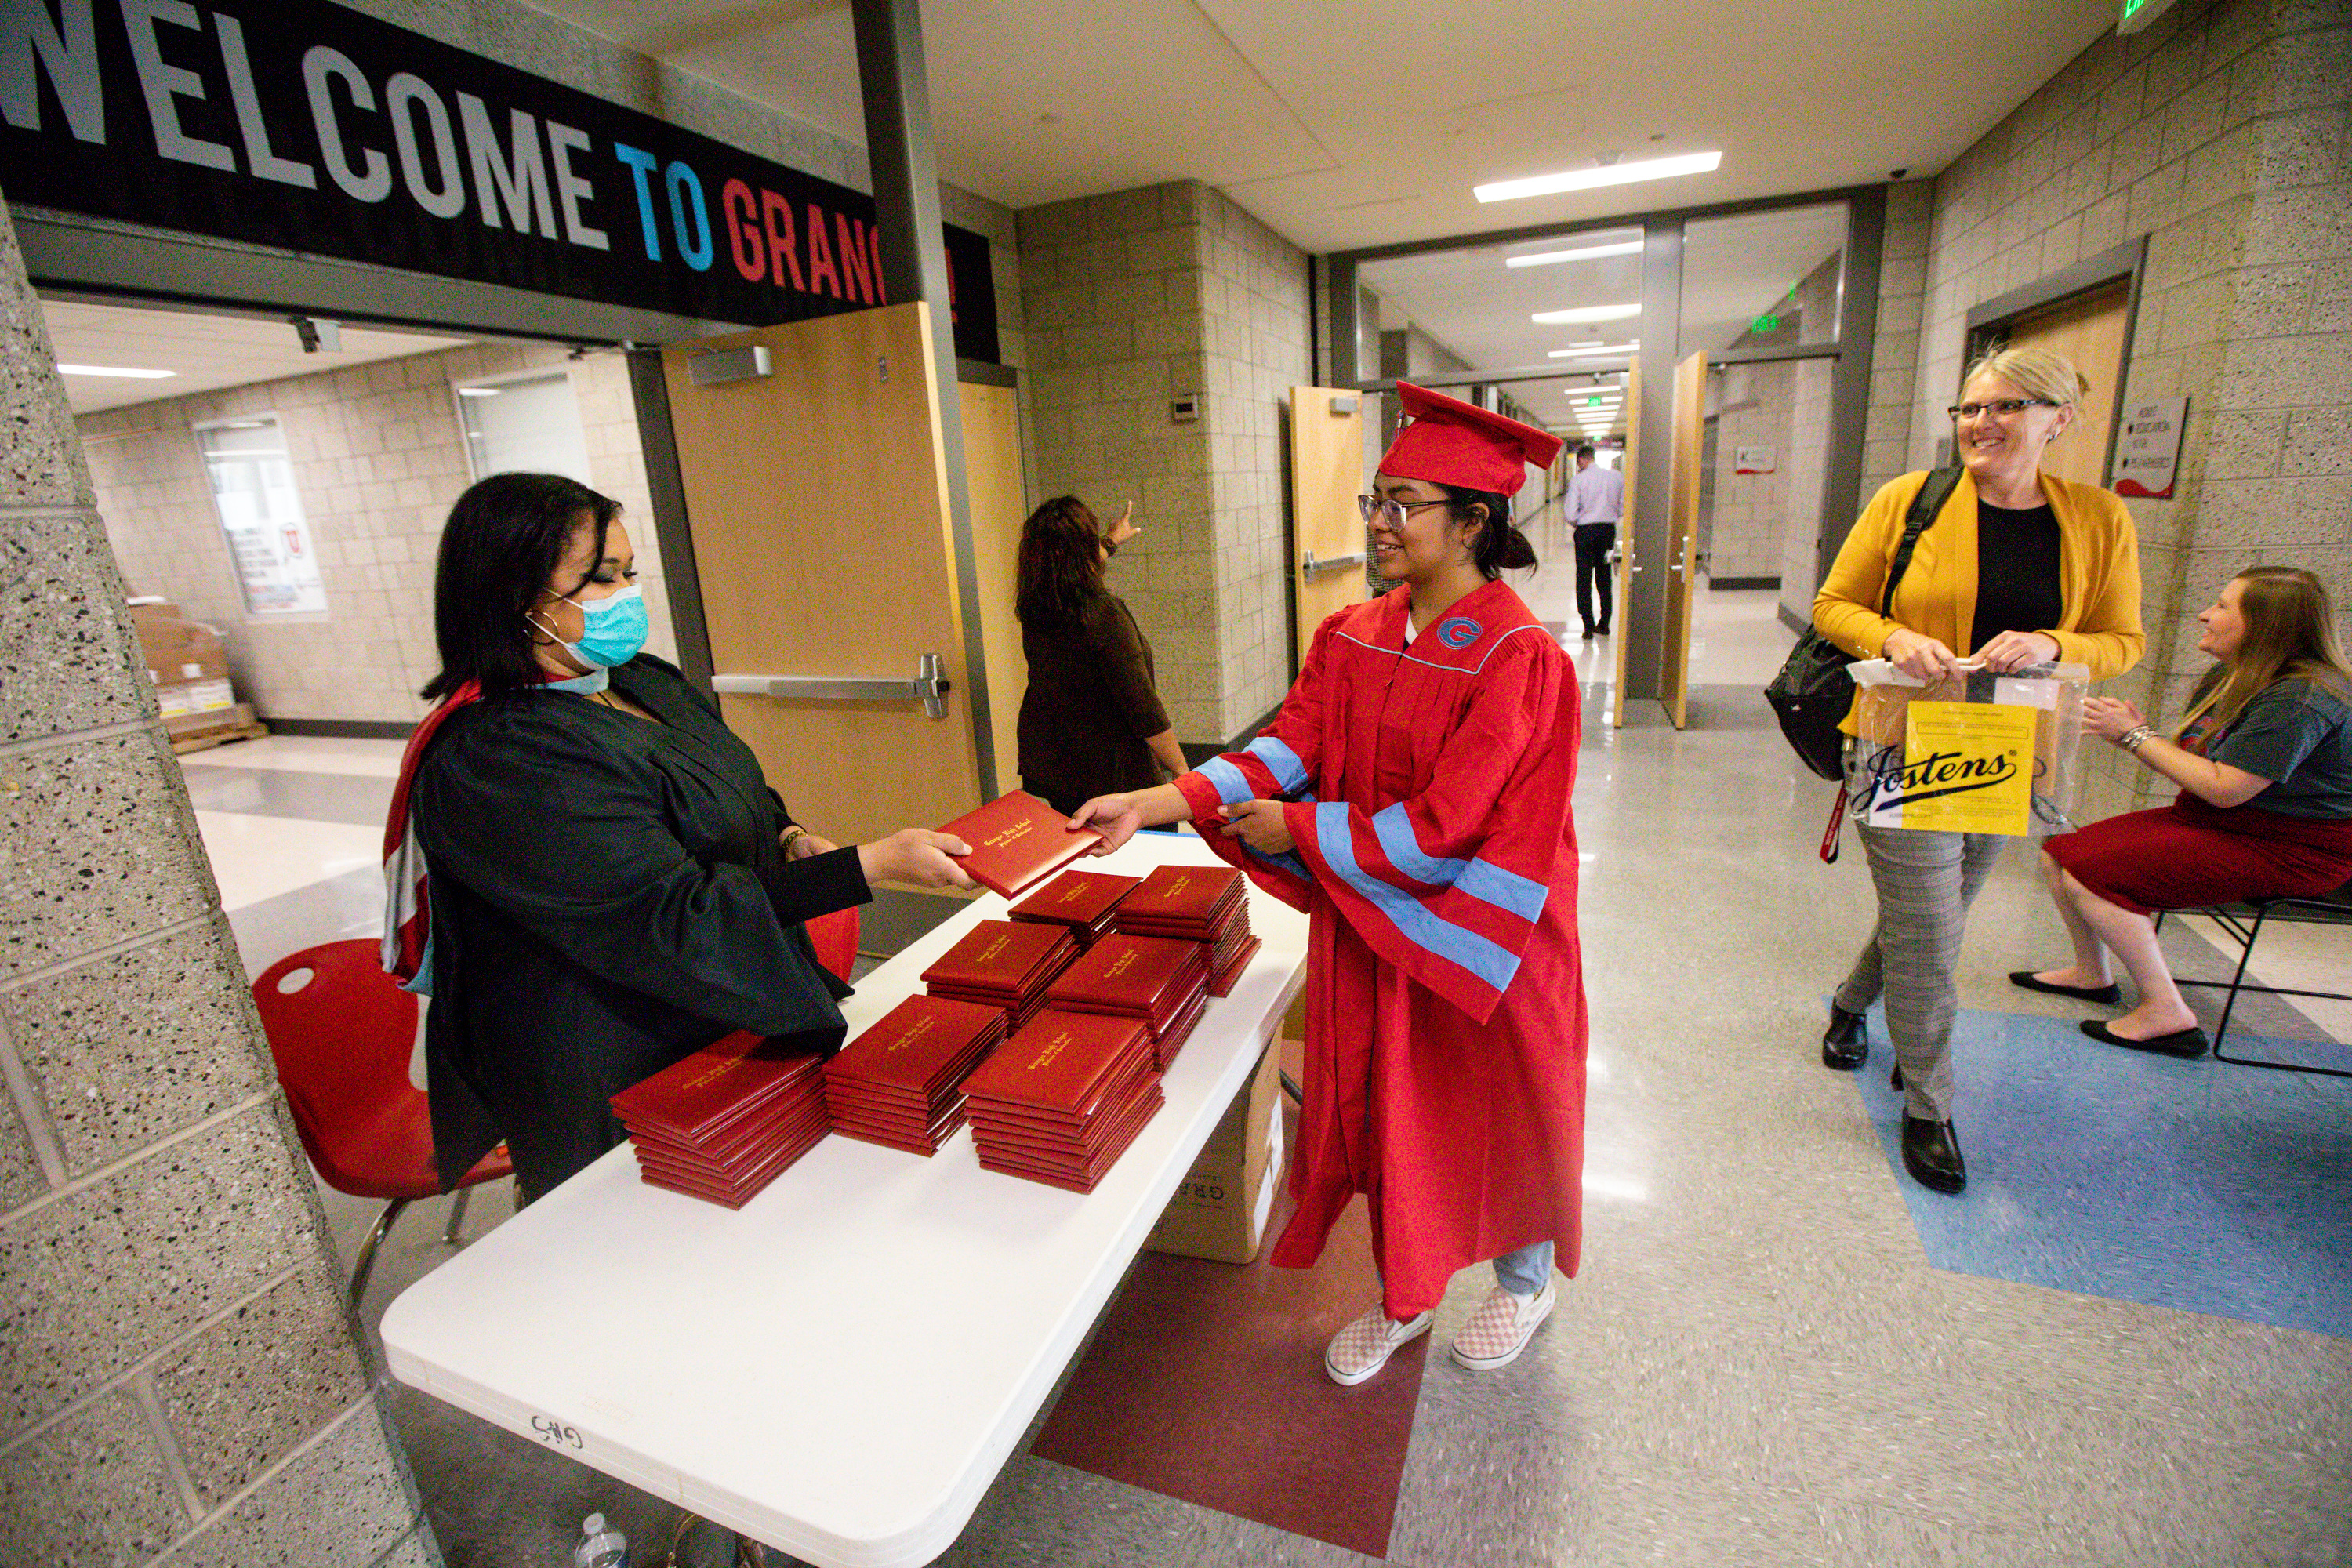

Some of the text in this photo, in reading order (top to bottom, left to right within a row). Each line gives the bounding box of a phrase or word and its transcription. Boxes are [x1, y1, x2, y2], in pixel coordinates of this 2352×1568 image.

[0, 0, 610, 252] WELCOME
[614, 141, 714, 272] TO
[1851, 745, 2017, 813] Jostens
